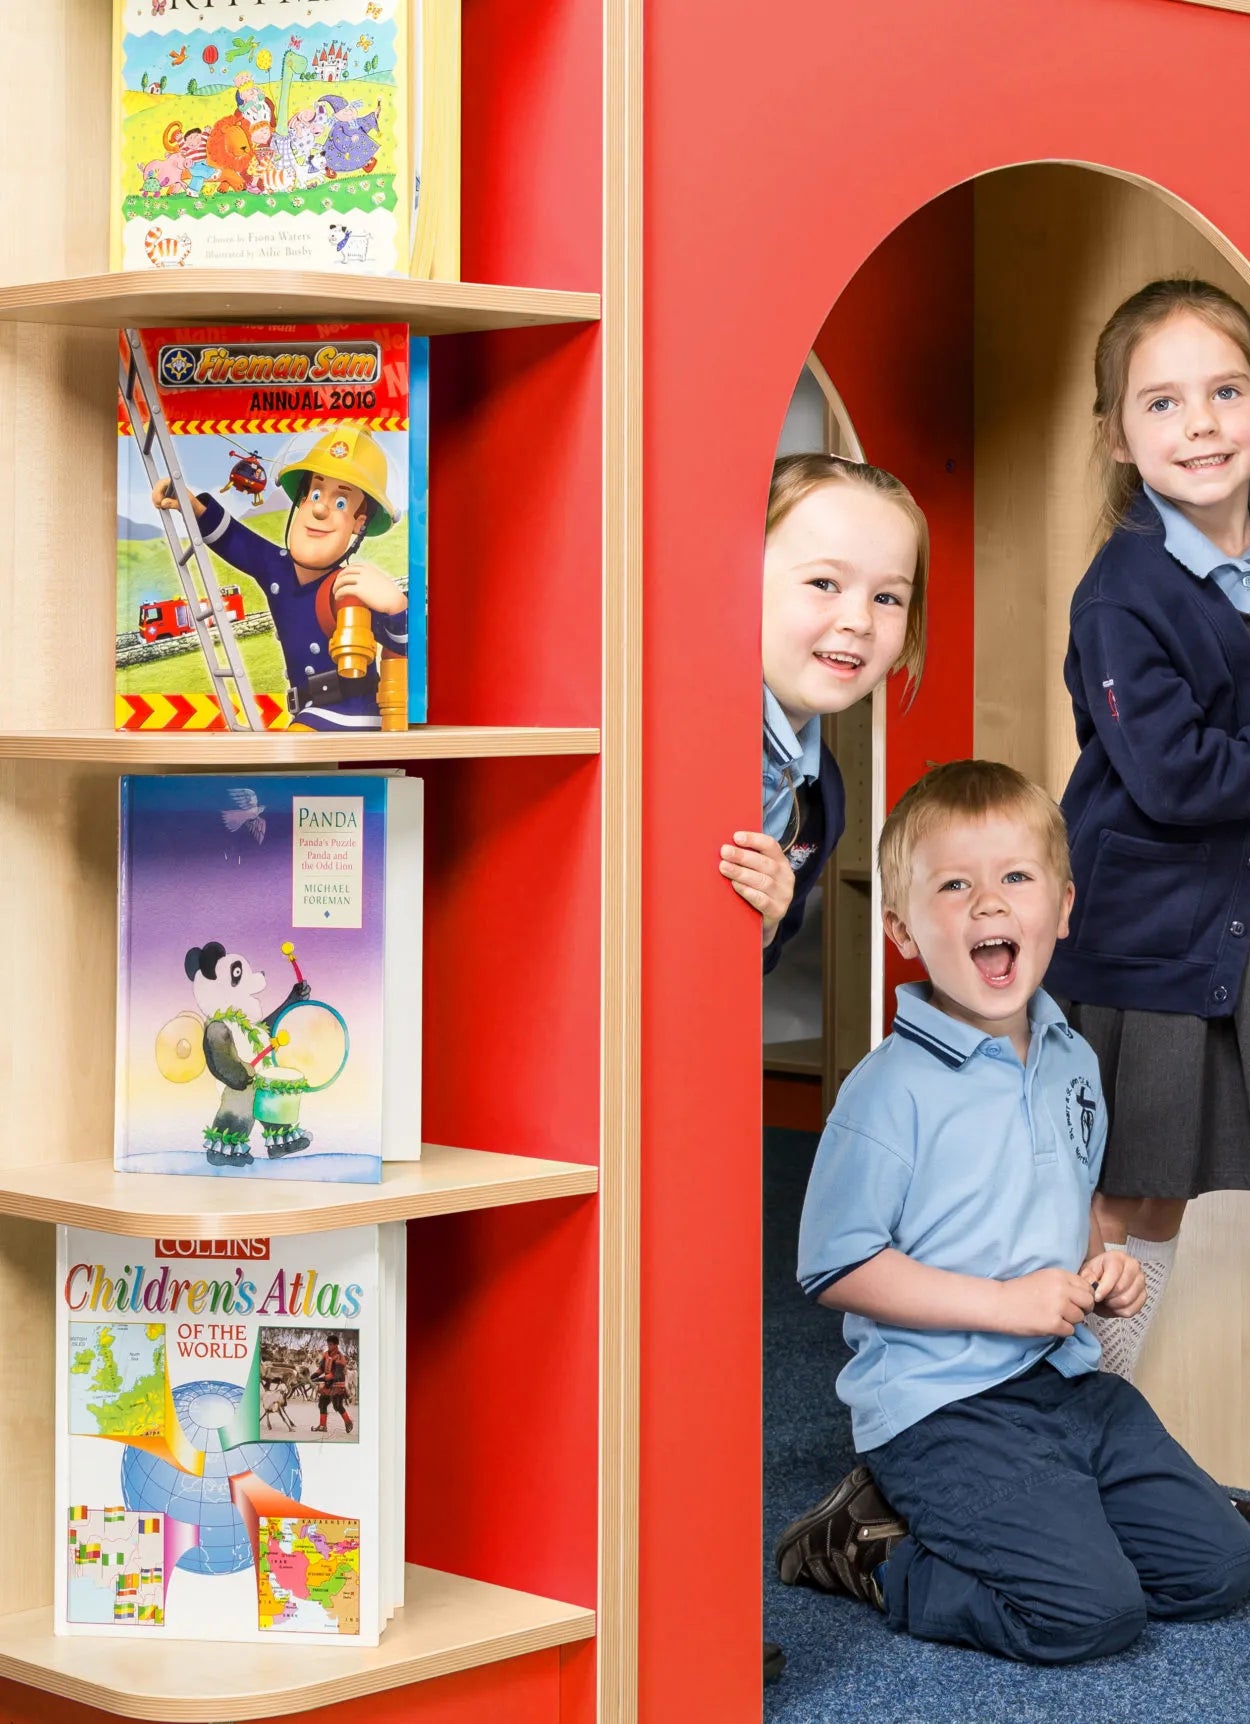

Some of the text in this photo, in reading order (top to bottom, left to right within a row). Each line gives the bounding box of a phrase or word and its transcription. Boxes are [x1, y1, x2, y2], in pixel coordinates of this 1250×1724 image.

[248, 231, 275, 242] Fiona
[279, 231, 312, 241] Waters
[196, 346, 377, 383] Fireman Sam
[250, 390, 376, 411] ANNUAL 2010
[299, 807, 357, 828] PANDA
[299, 838, 356, 847] Panda's Puzzle
[307, 851, 348, 860] Panda and
[301, 861, 353, 870] the Odd Lion
[304, 884, 350, 893] MICHAEL
[304, 896, 350, 905] FOREMAN
[159, 1237, 266, 1257] COLLINS
[65, 1263, 364, 1318] Children's Atlas
[178, 1323, 247, 1341] OF THE
[178, 1341, 248, 1360] WORLD
